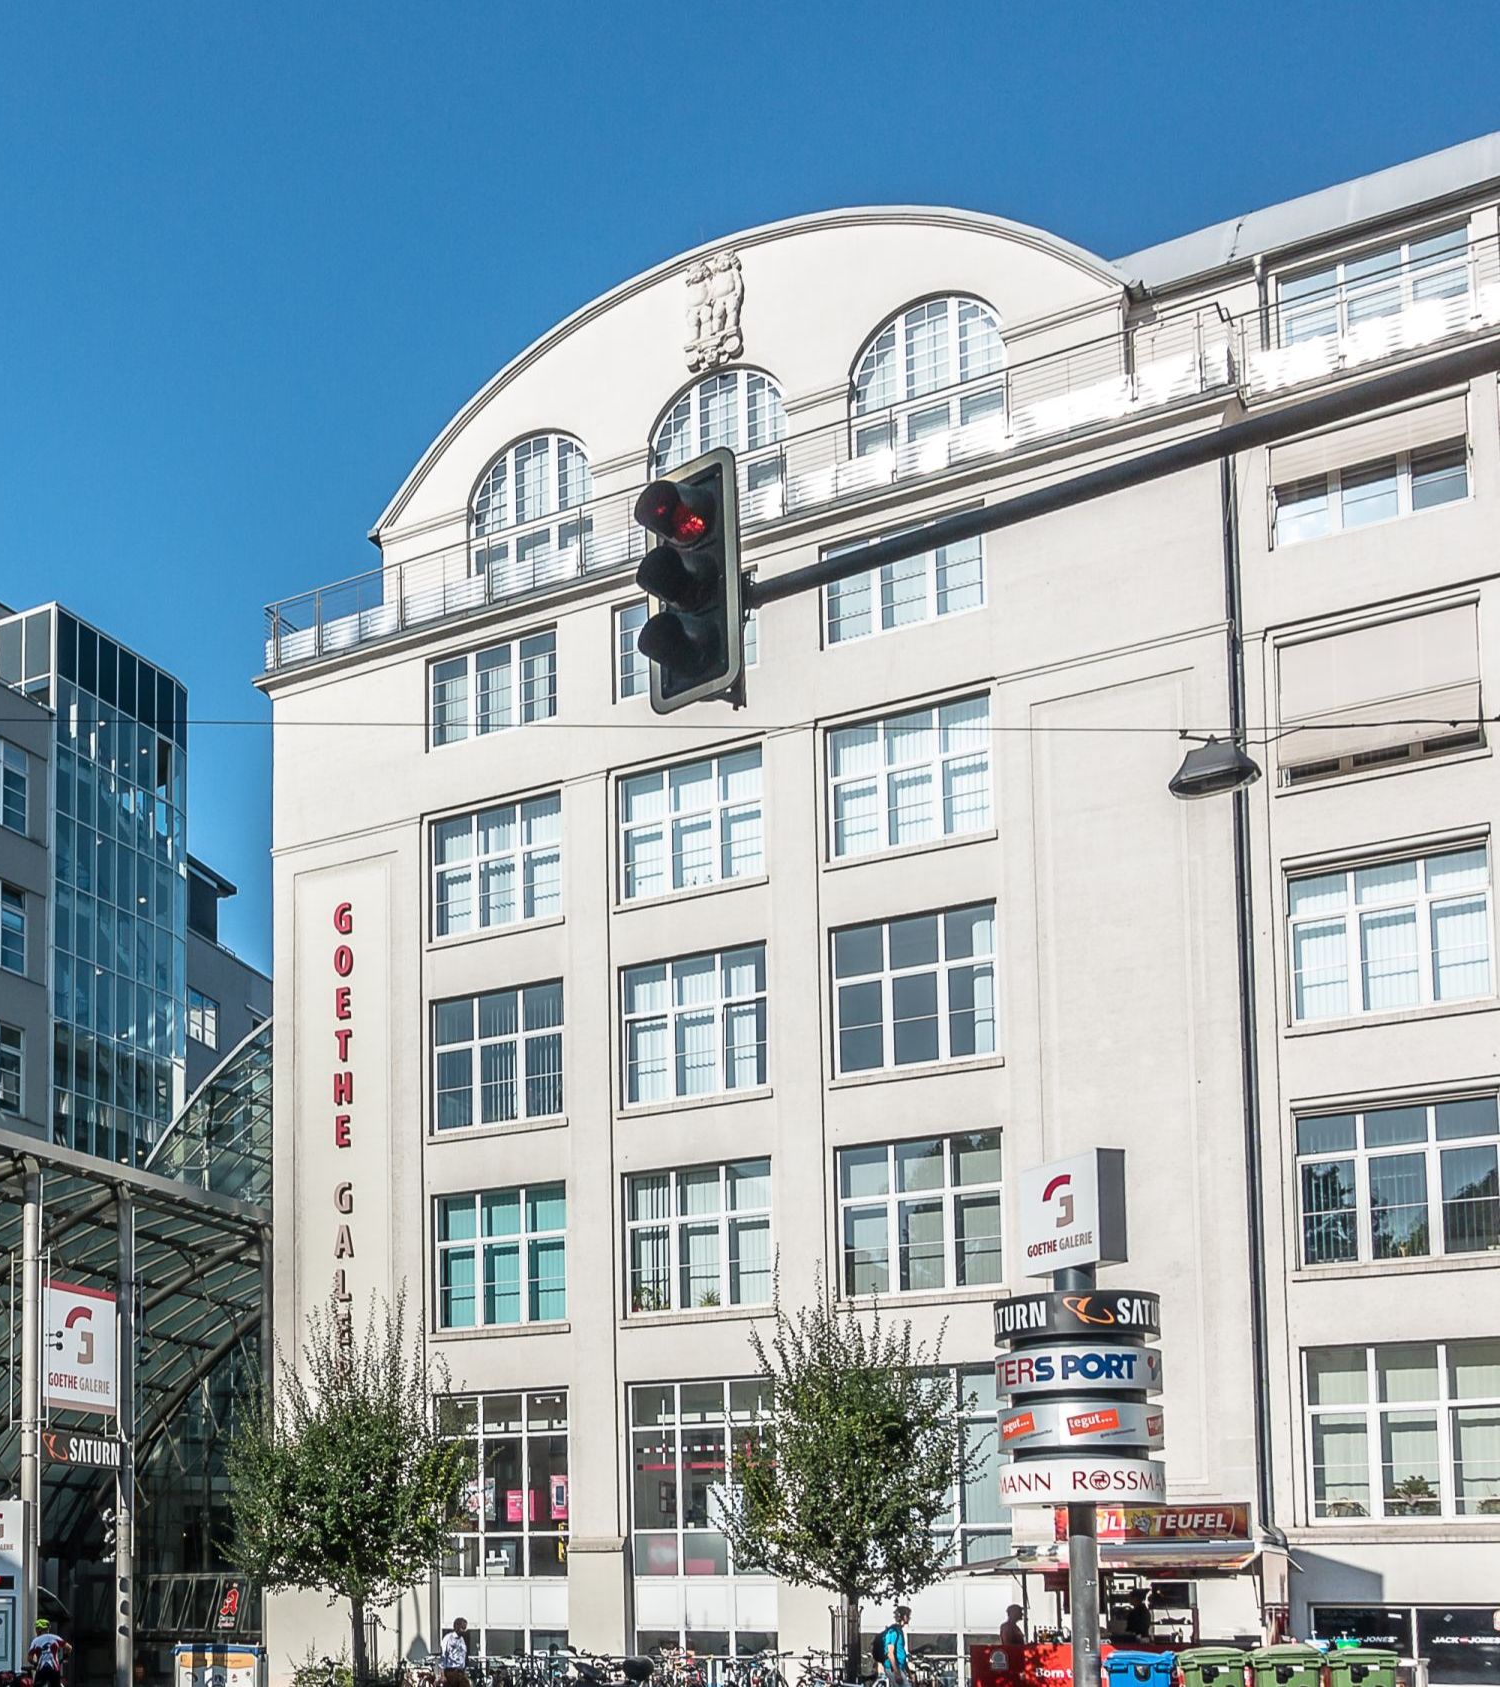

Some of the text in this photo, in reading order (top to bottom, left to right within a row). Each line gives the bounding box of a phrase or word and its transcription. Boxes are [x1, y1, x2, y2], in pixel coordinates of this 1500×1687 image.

[333, 902, 354, 1149] GOETHE
[1027, 1231, 1093, 1258] GOETHE GALERIE
[48, 1372, 111, 1395] GOETHE GALERIE
[69, 1437, 121, 1467] SATURN
[1152, 1513, 1228, 1532] TEUFEL
